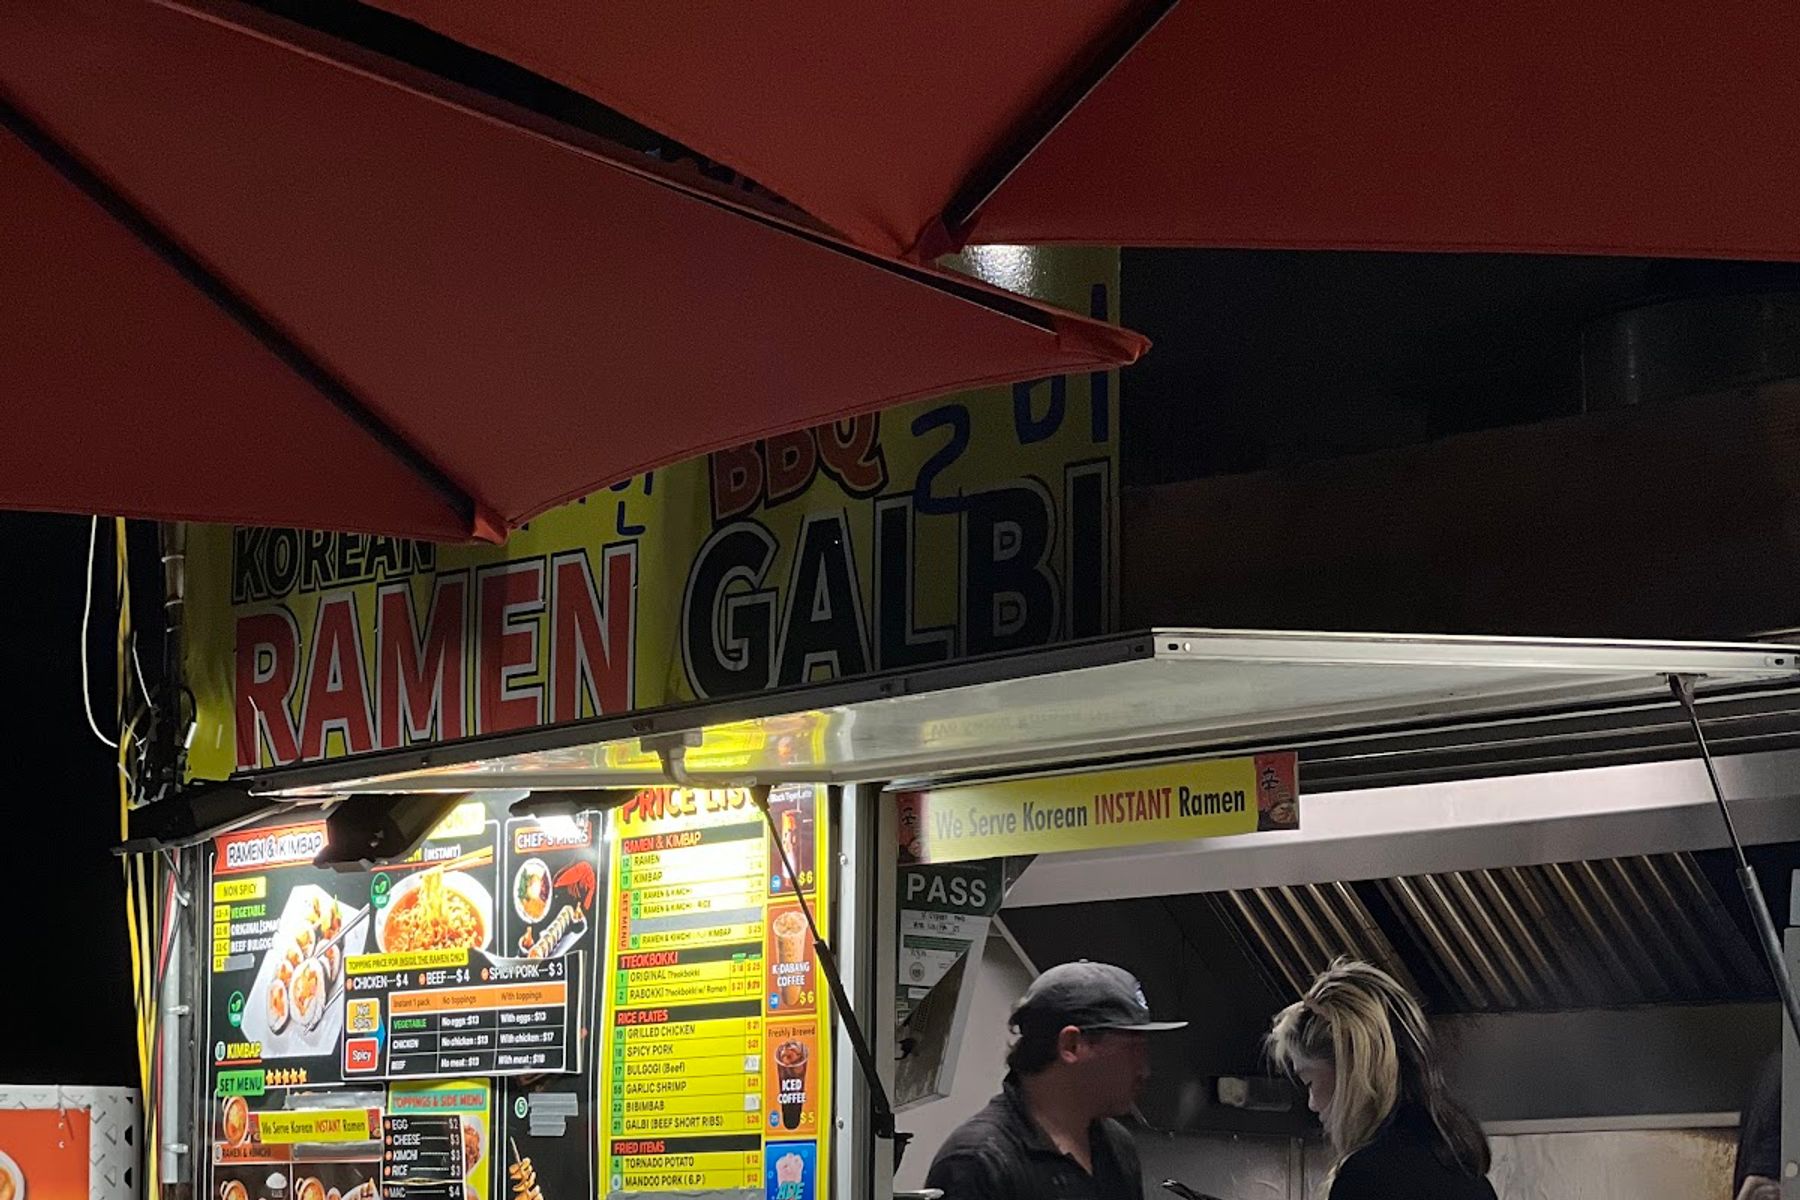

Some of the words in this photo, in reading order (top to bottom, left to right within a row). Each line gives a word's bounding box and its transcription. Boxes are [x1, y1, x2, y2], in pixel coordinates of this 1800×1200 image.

[232, 528, 436, 604] KOREAN
[709, 412, 888, 527] BBQ
[681, 457, 1111, 699] GALBI
[234, 542, 638, 773] RAMEN
[937, 811, 962, 839] We
[969, 807, 1016, 836] Serve
[1023, 801, 1088, 832] Korean
[1094, 788, 1171, 825] INSTANT
[1179, 786, 1245, 817] Ramen
[907, 873, 986, 907] PASS
[627, 1027, 660, 1039] GRILLED
[661, 1025, 695, 1037] CHICKEN
[768, 1026, 790, 1038] Freshly
[791, 1026, 815, 1036] Brewed
[220, 1076, 235, 1092] SET
[238, 1074, 262, 1090] MENU
[392, 1119, 408, 1130] EGG
[393, 1134, 421, 1145] CHEESE
[393, 1150, 418, 1161] KIMCHI
[625, 1158, 664, 1169] TORNADO
[664, 1156, 694, 1168] POTATO
[392, 1165, 408, 1176] RICE
[389, 1186, 406, 1198] MAC
